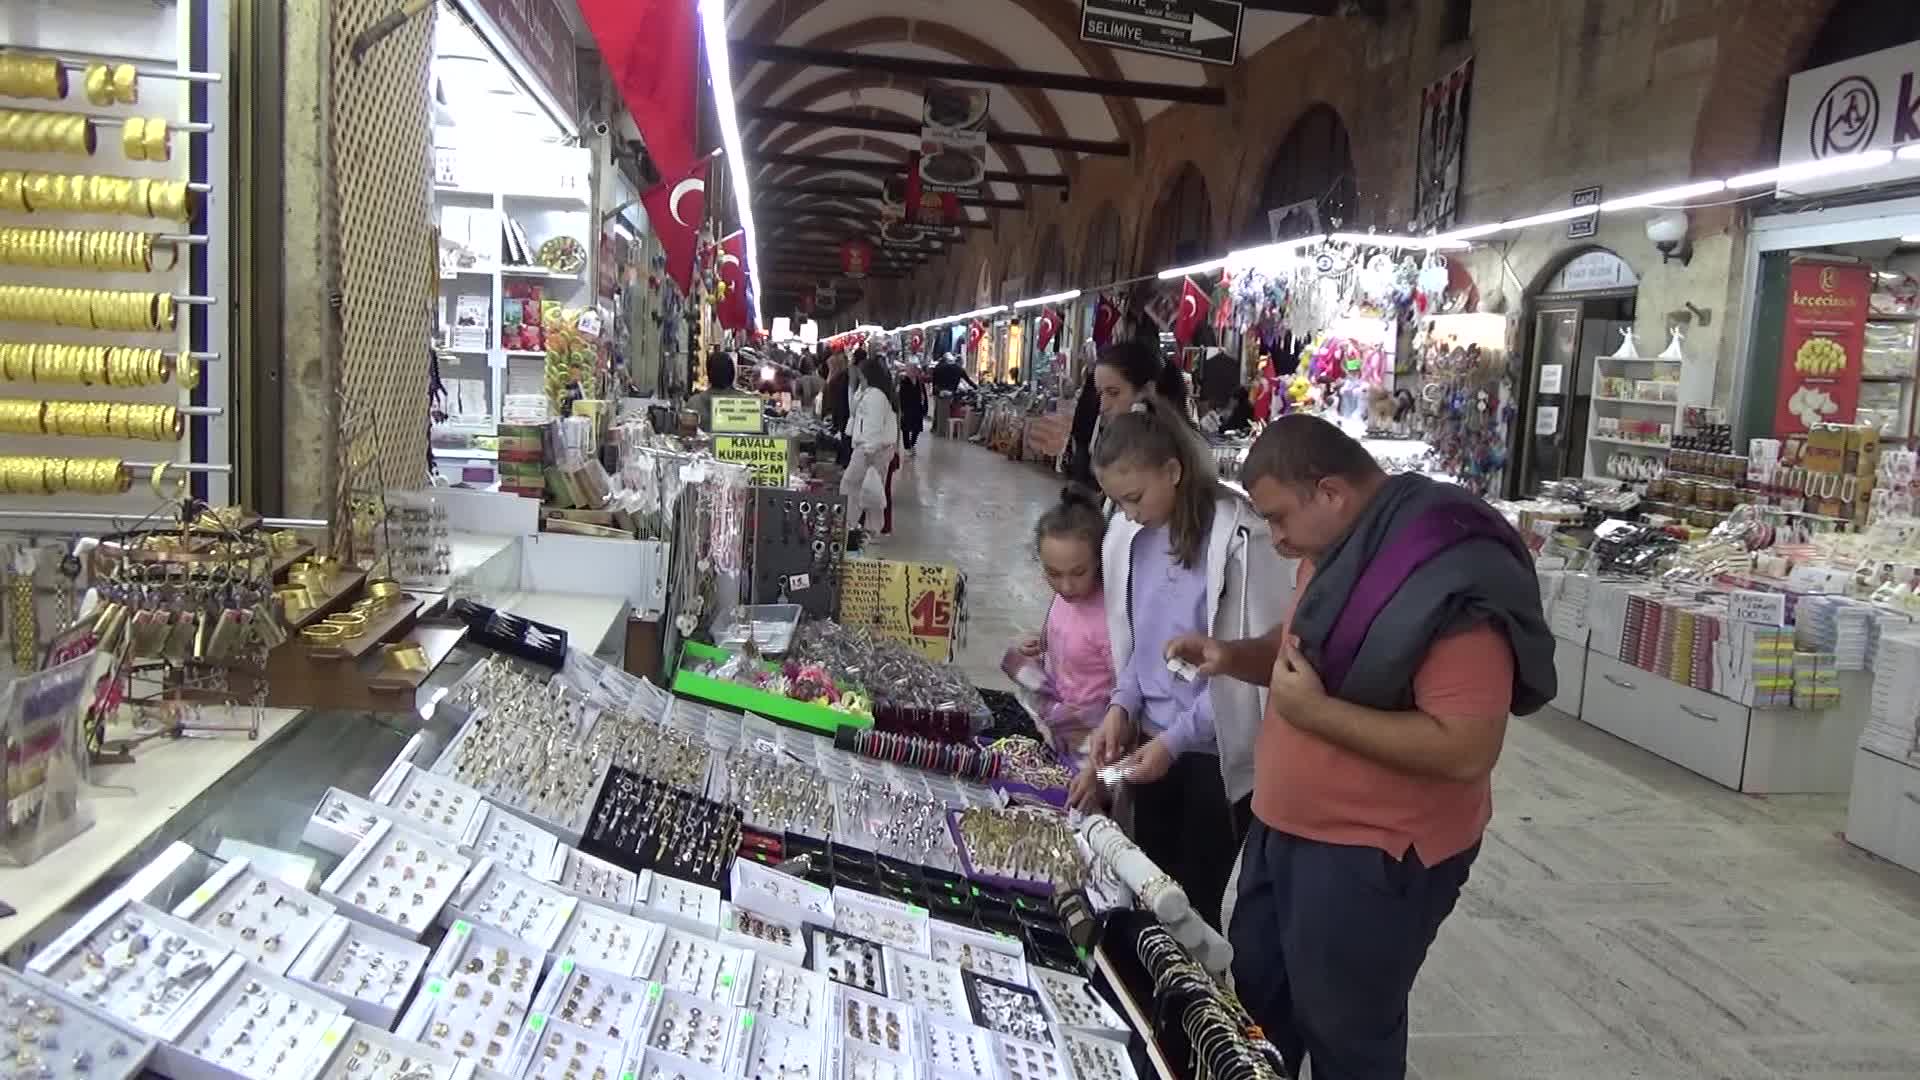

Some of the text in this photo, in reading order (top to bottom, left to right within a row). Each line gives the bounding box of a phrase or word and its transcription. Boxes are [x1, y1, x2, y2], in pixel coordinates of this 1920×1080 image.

[1088, 20, 1143, 40] SELİMİYE
[731, 437, 775, 448] KAVALA
[718, 450, 788, 462] KURABİYESİ
